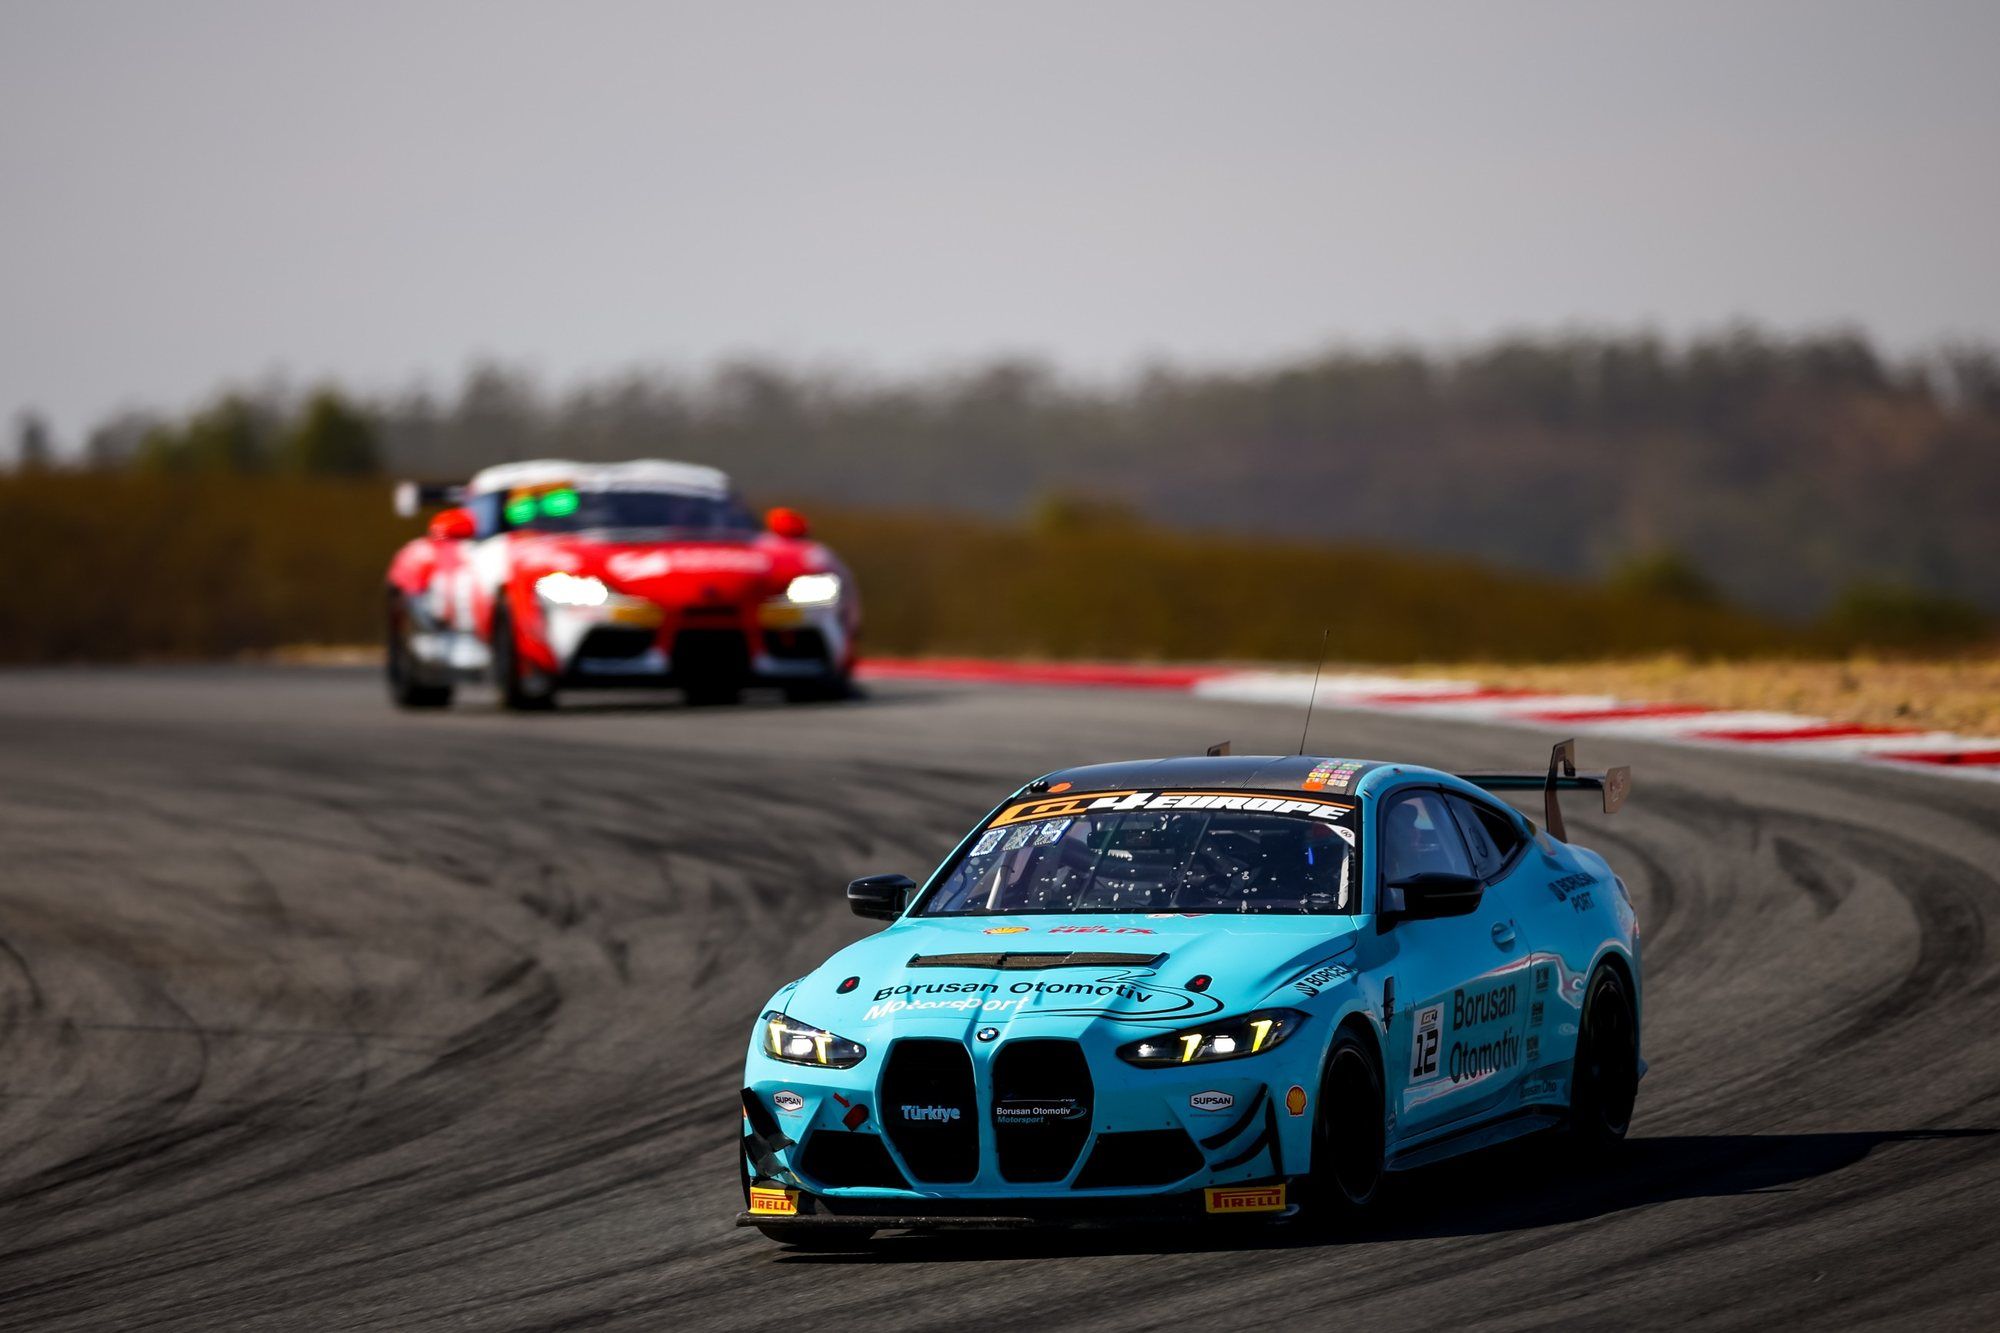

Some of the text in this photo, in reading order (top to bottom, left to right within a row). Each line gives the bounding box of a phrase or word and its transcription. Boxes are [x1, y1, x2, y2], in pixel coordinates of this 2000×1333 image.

[1144, 796, 1351, 820] EUROPE
[1048, 926, 1159, 935] HELIX
[873, 980, 1153, 1004] Borusan Otomotiv
[862, 996, 1030, 1021] Motorsport
[1452, 984, 1516, 1031] Borusan
[1413, 1029, 1439, 1077] 12
[1450, 1027, 1520, 1084] Otomotiv
[775, 1095, 802, 1106] SUPSAN
[1193, 1097, 1231, 1105] SUPSAN
[901, 1105, 961, 1123] Türkiye
[996, 1107, 1071, 1115] Borusan Otomotiv
[997, 1116, 1045, 1124] Motorsport
[752, 1192, 793, 1211] PIRELLI
[1213, 1188, 1281, 1208] PIRELLI
